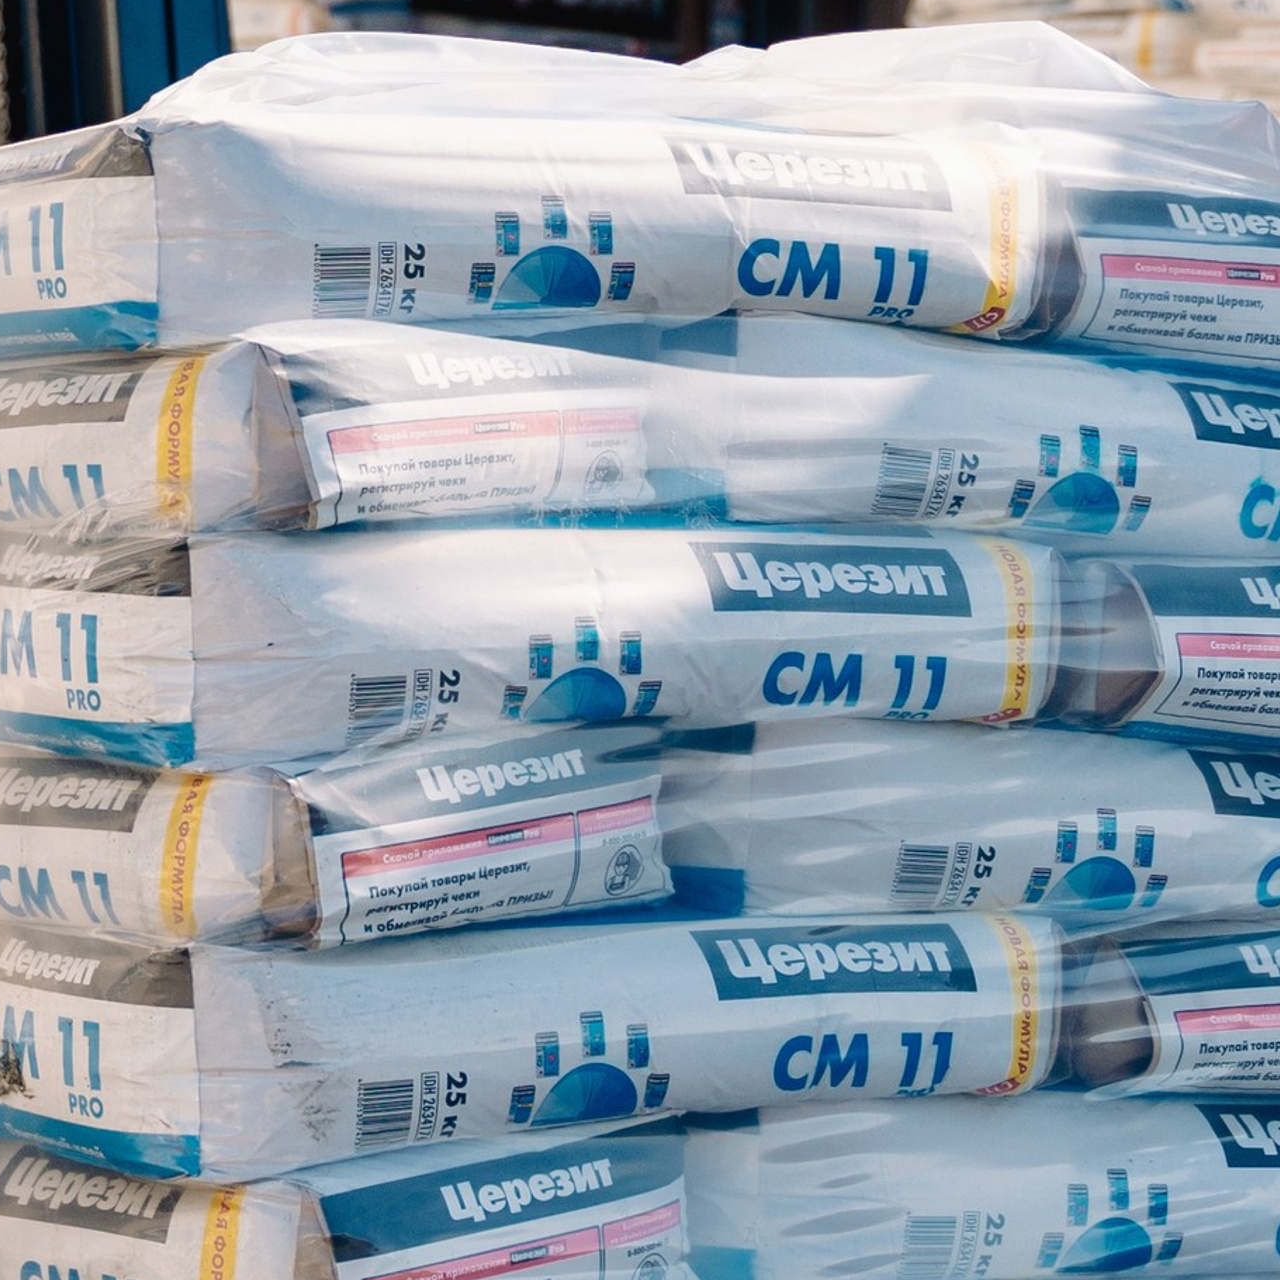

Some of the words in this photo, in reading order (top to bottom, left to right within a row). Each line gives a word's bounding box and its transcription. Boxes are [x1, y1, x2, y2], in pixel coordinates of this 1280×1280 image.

[683, 143, 929, 192] Церезит
[28, 201, 65, 273] 11
[380, 244, 395, 265] IDH
[403, 243, 426, 279] 25
[36, 277, 68, 299] PRO
[874, 246, 929, 306] 11
[1113, 308, 1187, 324] регистрируй
[1190, 313, 1217, 323] чеки
[1119, 288, 1170, 304] Покупай
[1172, 293, 1214, 307] товары
[1216, 295, 1265, 310] Церезит,
[1118, 322, 1184, 338] обменивай
[1187, 328, 1224, 342] баллы
[1227, 333, 1242, 342] на
[405, 350, 574, 389] Церезит
[358, 459, 417, 477] Покупай
[418, 454, 463, 471] товары
[464, 451, 516, 467] Церезит,
[957, 453, 980, 487] 25
[359, 476, 438, 497] регистрируй
[438, 476, 468, 489] чеки
[714, 551, 948, 600] Церезит
[56, 612, 99, 683] 11
[416, 672, 430, 693] IDH
[439, 670, 461, 704] 25
[892, 654, 947, 710] 11
[1197, 667, 1245, 683] Покупай
[65, 688, 102, 712] PRO
[1189, 686, 1261, 700] регистрируй
[1192, 699, 1257, 714] обменивай
[415, 748, 587, 804] Церезит
[382, 848, 421, 865] Скачай
[956, 843, 971, 865] IDH
[974, 846, 996, 879] 25
[171, 820, 190, 925] ФОРМУЛА
[369, 878, 429, 900] Покупай
[430, 871, 476, 893] товары
[478, 861, 532, 882] Церезит,
[70, 870, 122, 925] 11
[365, 892, 449, 918] регистрируй
[451, 888, 481, 902] чеки
[714, 938, 954, 985] Церезит
[57, 1016, 103, 1092] 11
[898, 1031, 954, 1087] 11
[1199, 1041, 1249, 1057] Покупай
[423, 1074, 437, 1096] IDH
[445, 1071, 468, 1108] 25
[67, 1092, 105, 1120] PRO
[4, 1156, 174, 1220] Церезит
[440, 1157, 616, 1223] Церезит
[982, 1213, 1005, 1248] 25
